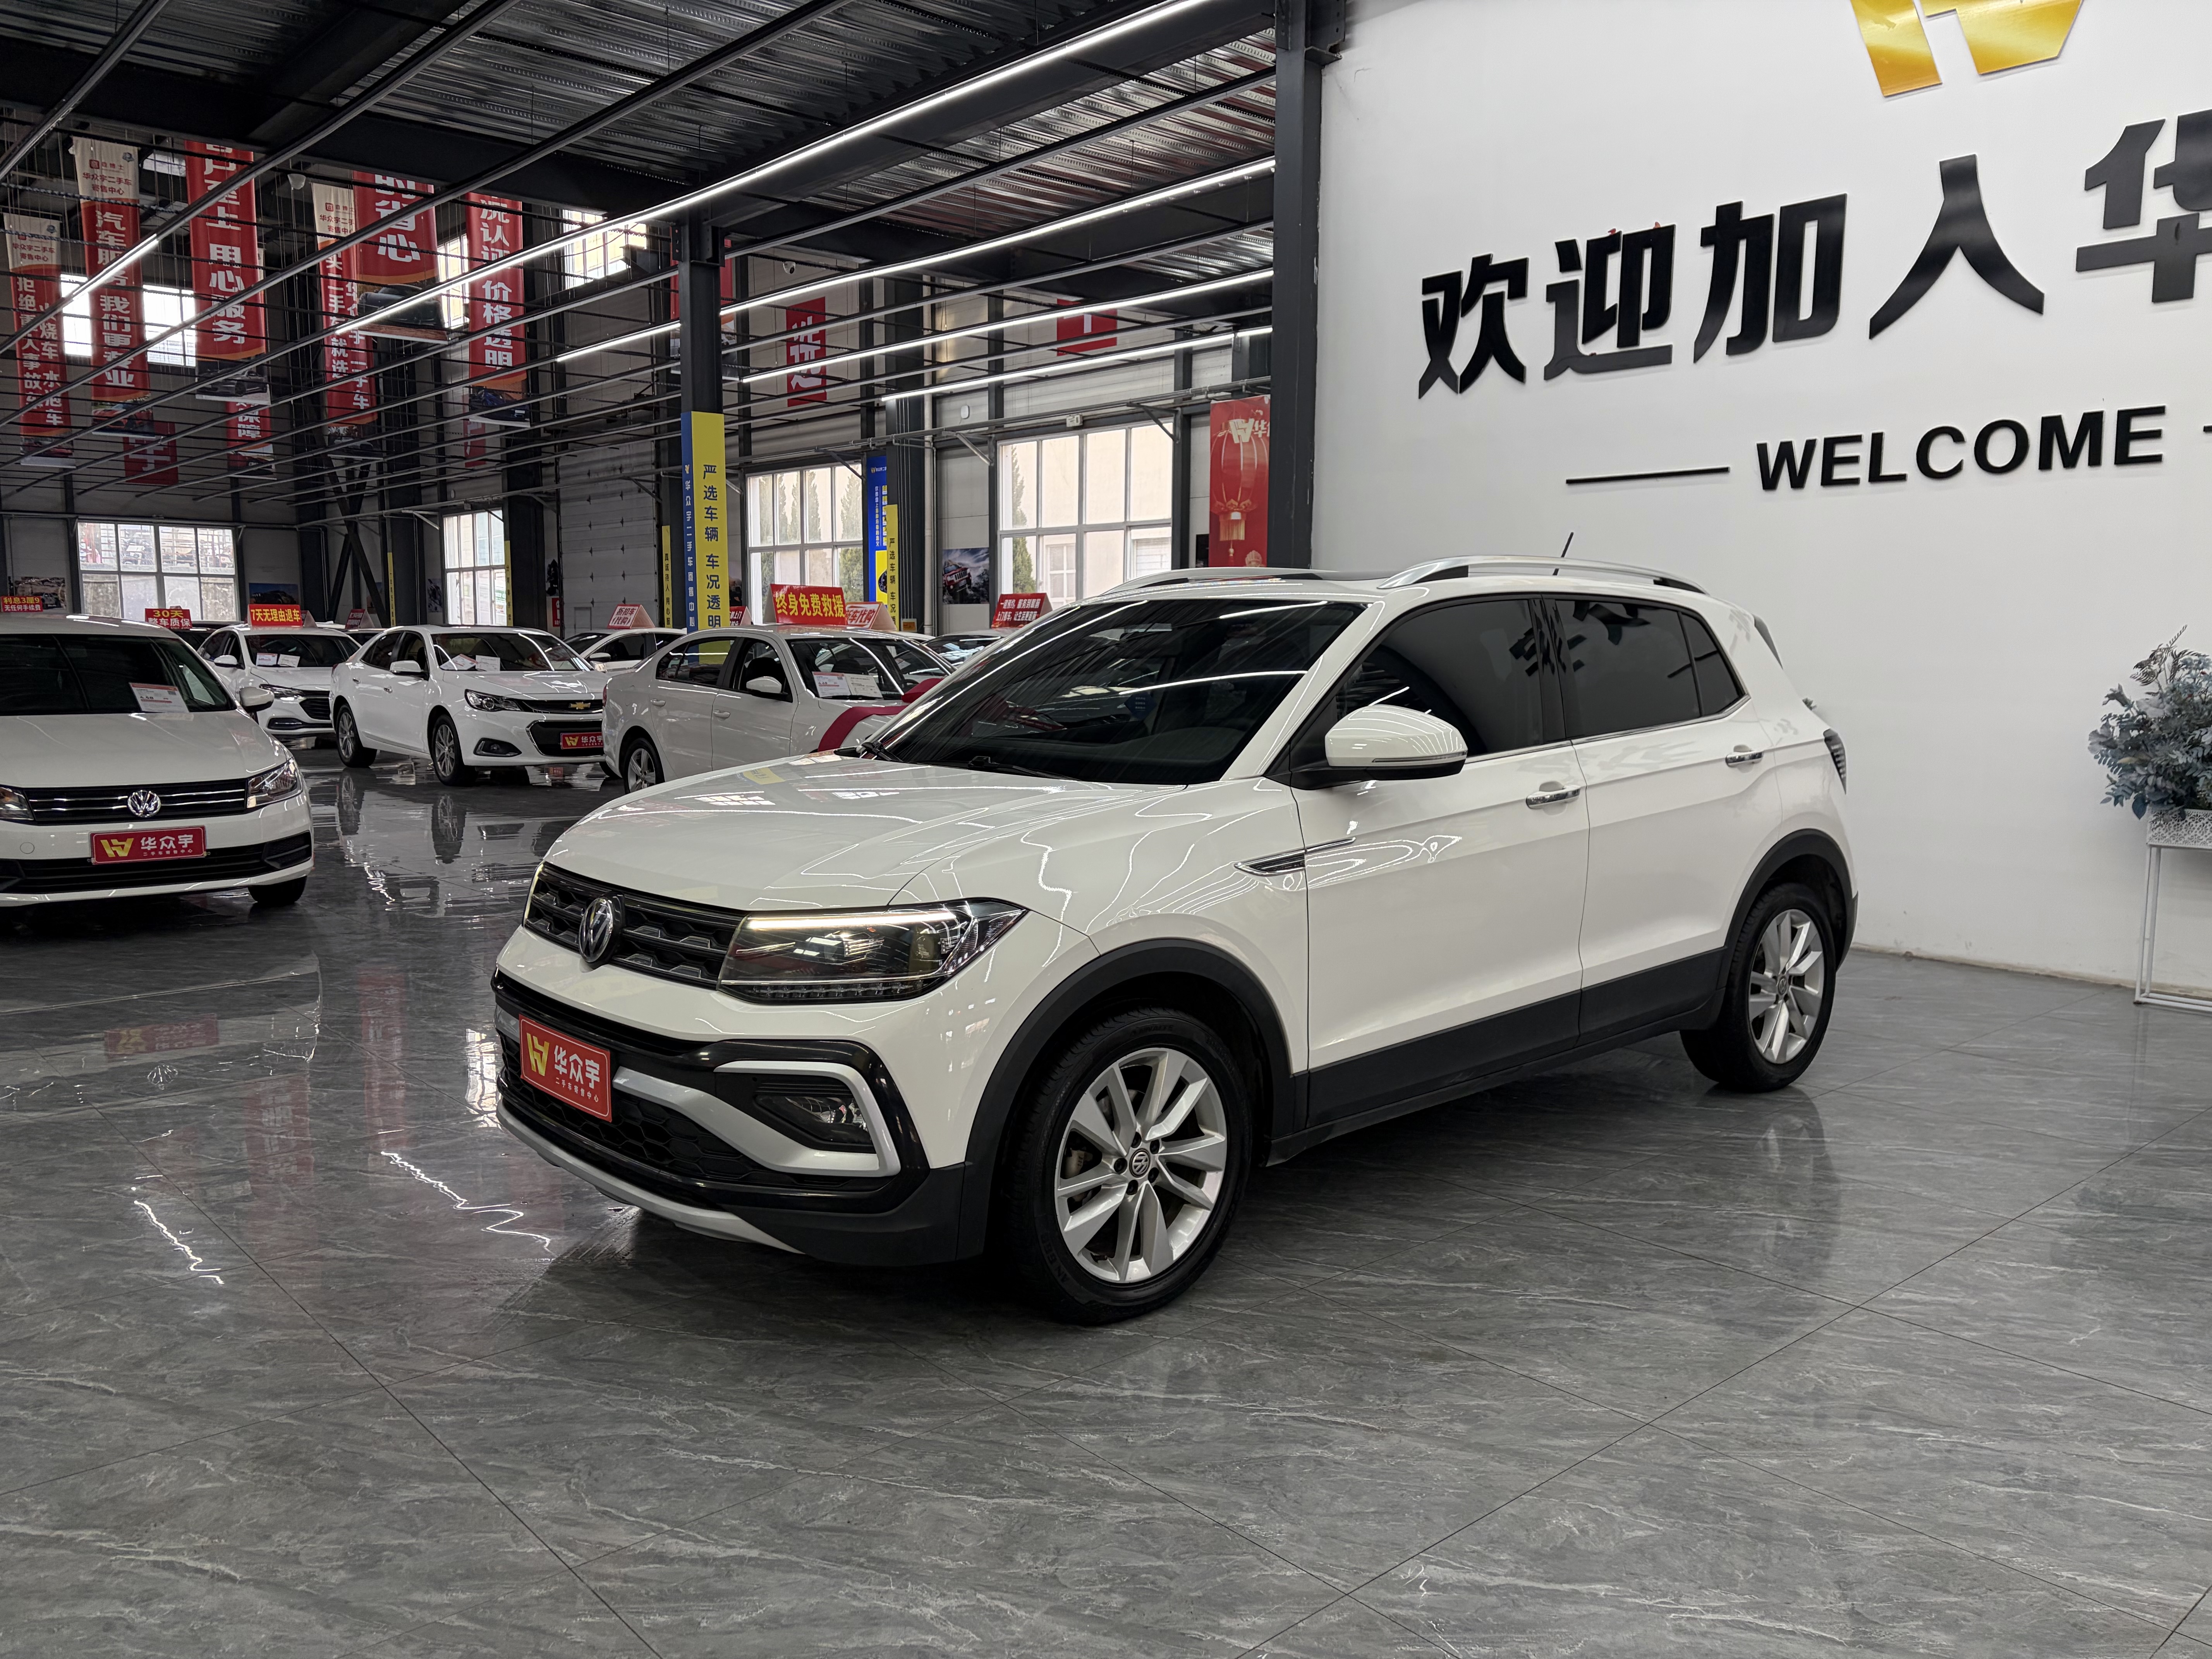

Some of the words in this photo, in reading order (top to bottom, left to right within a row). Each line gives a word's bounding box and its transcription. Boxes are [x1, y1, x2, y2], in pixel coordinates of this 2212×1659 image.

[82, 172, 132, 185] 华众宇二手车
[12, 242, 55, 254] 华众宇二手车
[482, 280, 513, 371] 价格透明
[790, 316, 822, 390] 选
[1755, 405, 2167, 493] WELCOME
[703, 464, 718, 542] 严选车辆
[706, 553, 721, 628] 车况透明
[153, 610, 184, 618] 30天
[251, 608, 301, 622] 7天无理由退车
[775, 591, 845, 618] 终身免费救援
[148, 617, 191, 627] 整车质保
[141, 834, 194, 850] 华众宇
[554, 1045, 600, 1089] 华众宇
[555, 1077, 599, 1103] 二手车寄售中心
